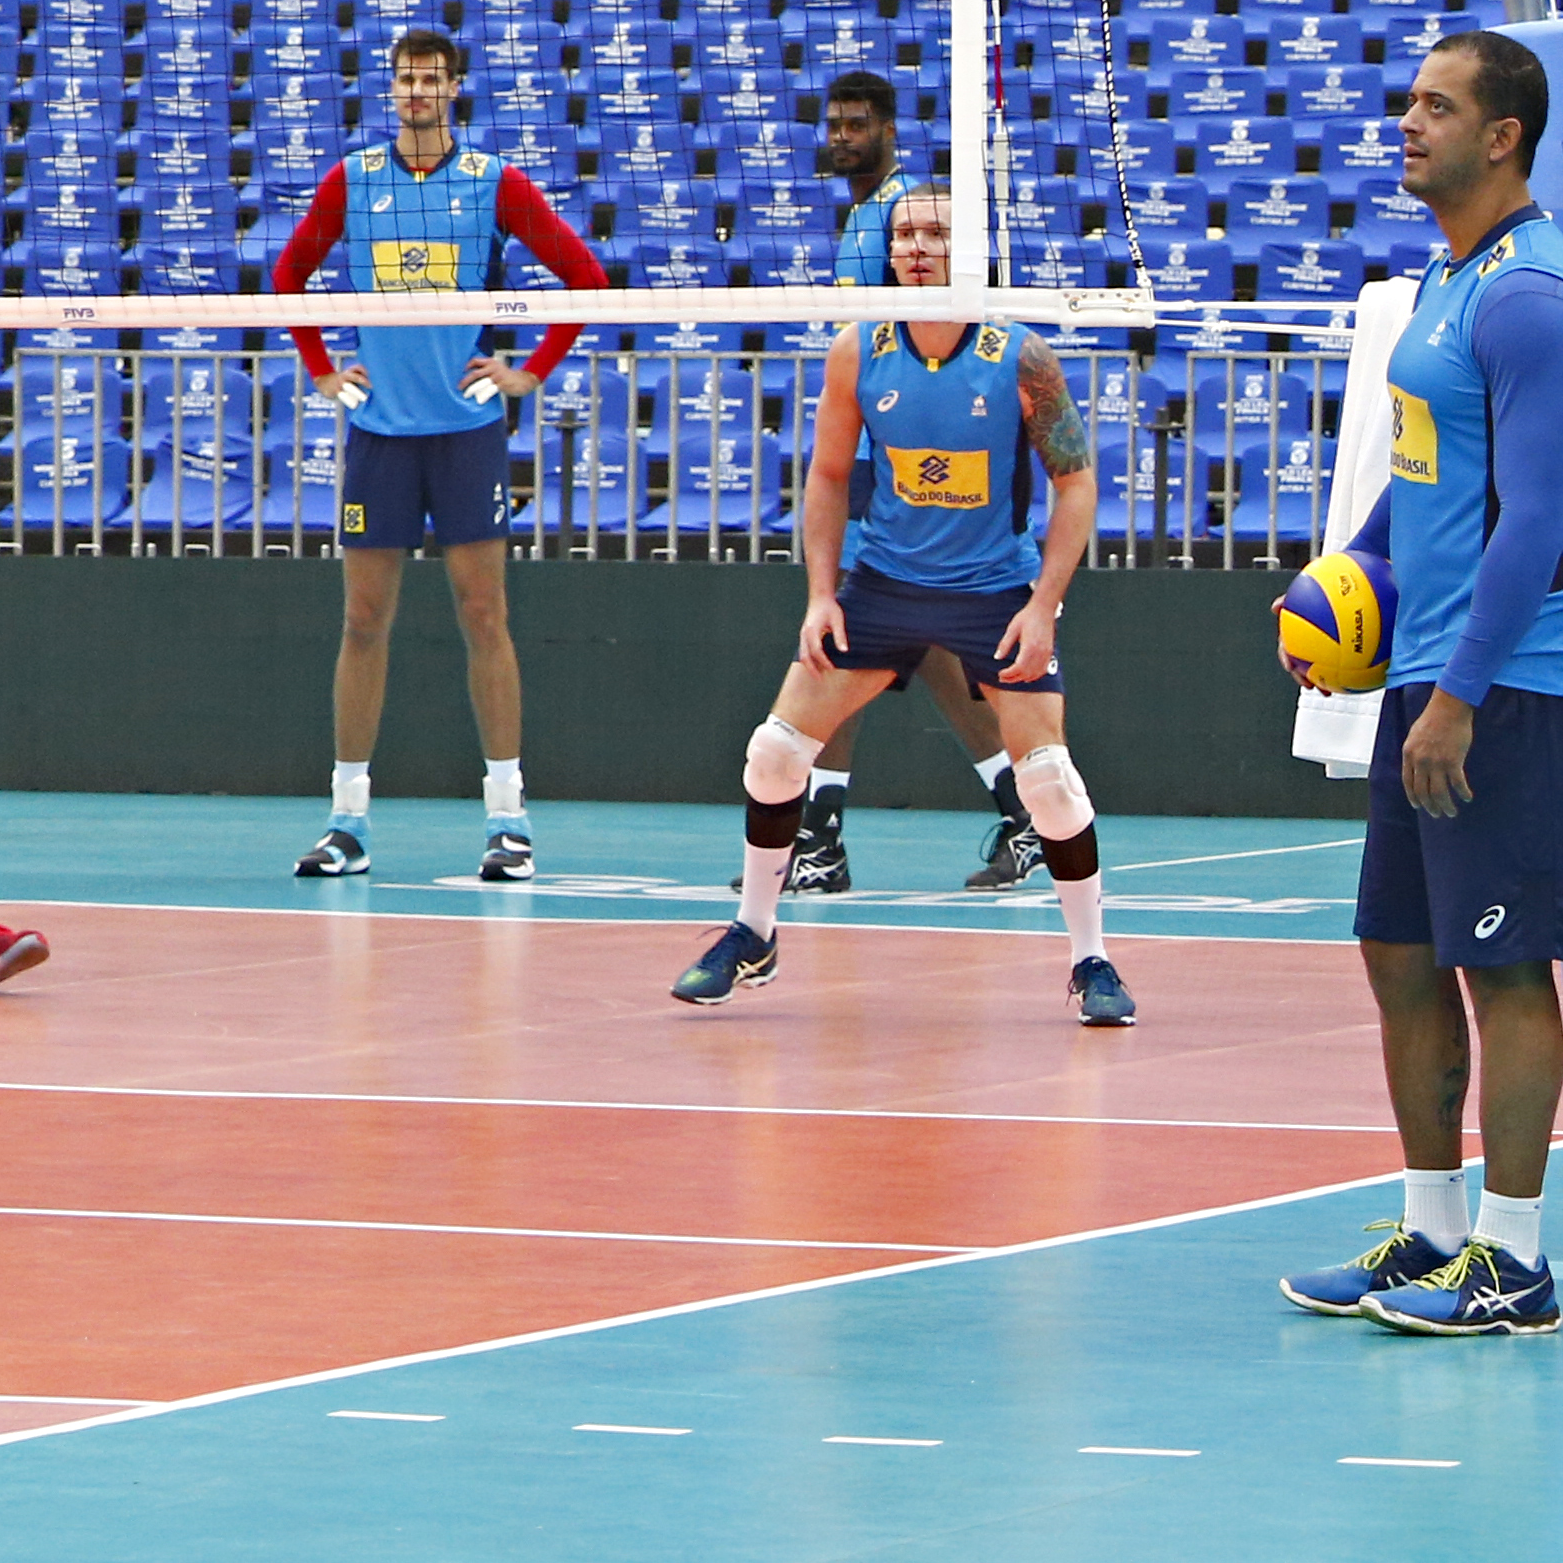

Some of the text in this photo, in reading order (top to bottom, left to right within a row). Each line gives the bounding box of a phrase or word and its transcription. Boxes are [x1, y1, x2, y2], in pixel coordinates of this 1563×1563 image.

[63, 308, 95, 320] FIVB
[495, 302, 528, 314] FIVB
[928, 491, 943, 501] DO
[944, 491, 982, 504] BRASIL
